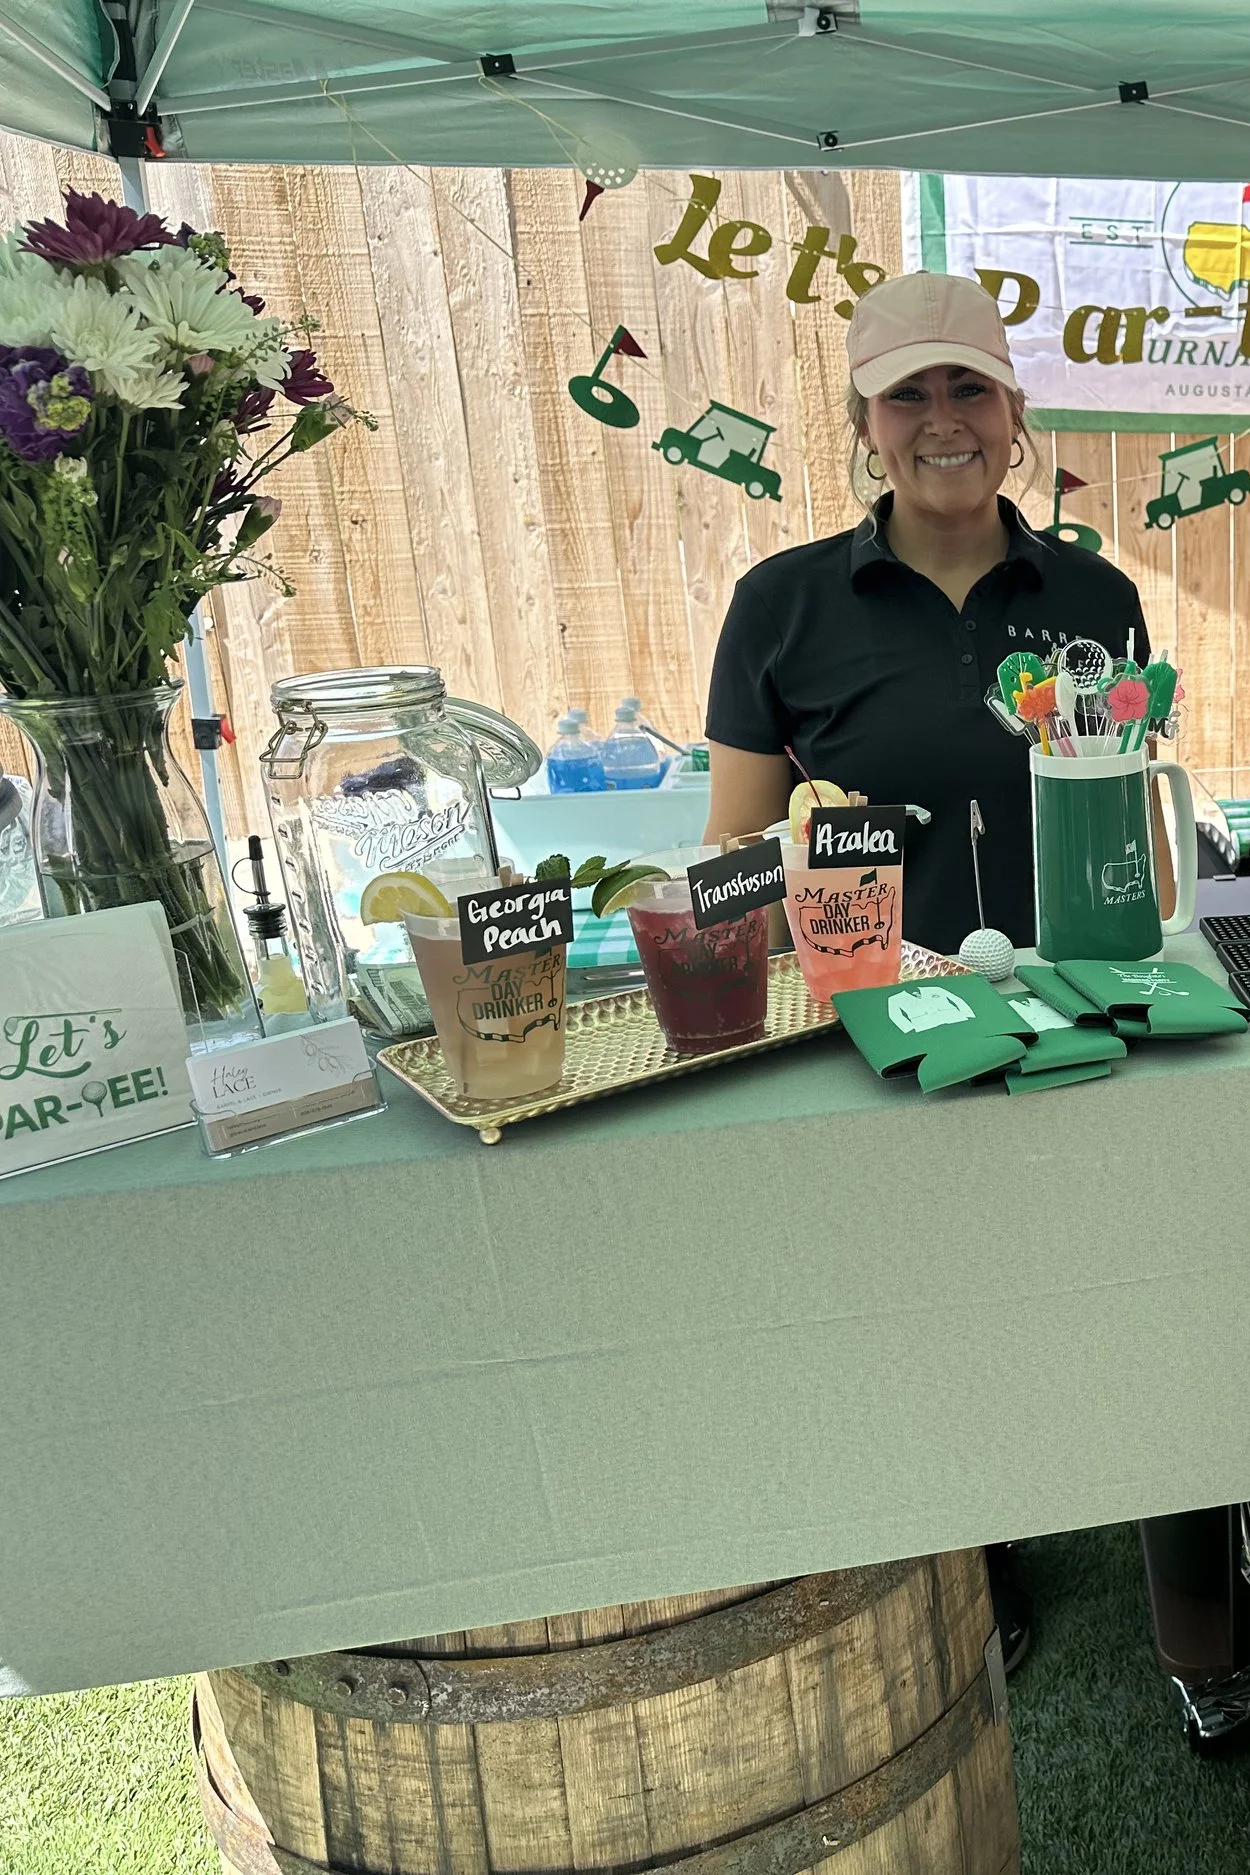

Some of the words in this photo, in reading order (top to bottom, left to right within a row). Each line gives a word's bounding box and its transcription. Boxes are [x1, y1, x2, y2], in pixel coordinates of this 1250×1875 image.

[1081, 223, 1144, 242] EST
[1007, 624, 1083, 645] BARR
[815, 820, 899, 857] Azalea
[692, 864, 784, 914] Transfusion
[795, 882, 888, 904] MASTER
[1103, 889, 1146, 906] MASTERS
[467, 887, 570, 925] Georgia
[823, 902, 852, 919] DAY
[483, 918, 563, 953] Peach
[653, 920, 757, 945] MASTER
[809, 914, 870, 935] DRINKER
[452, 952, 561, 985] MASTER
[491, 978, 523, 1001] DAY
[472, 992, 544, 1021] DRINKER
[0, 1015, 127, 1081] Let's
[212, 1075, 257, 1100] LACE
[0, 1066, 168, 1140] AR-TEE!
